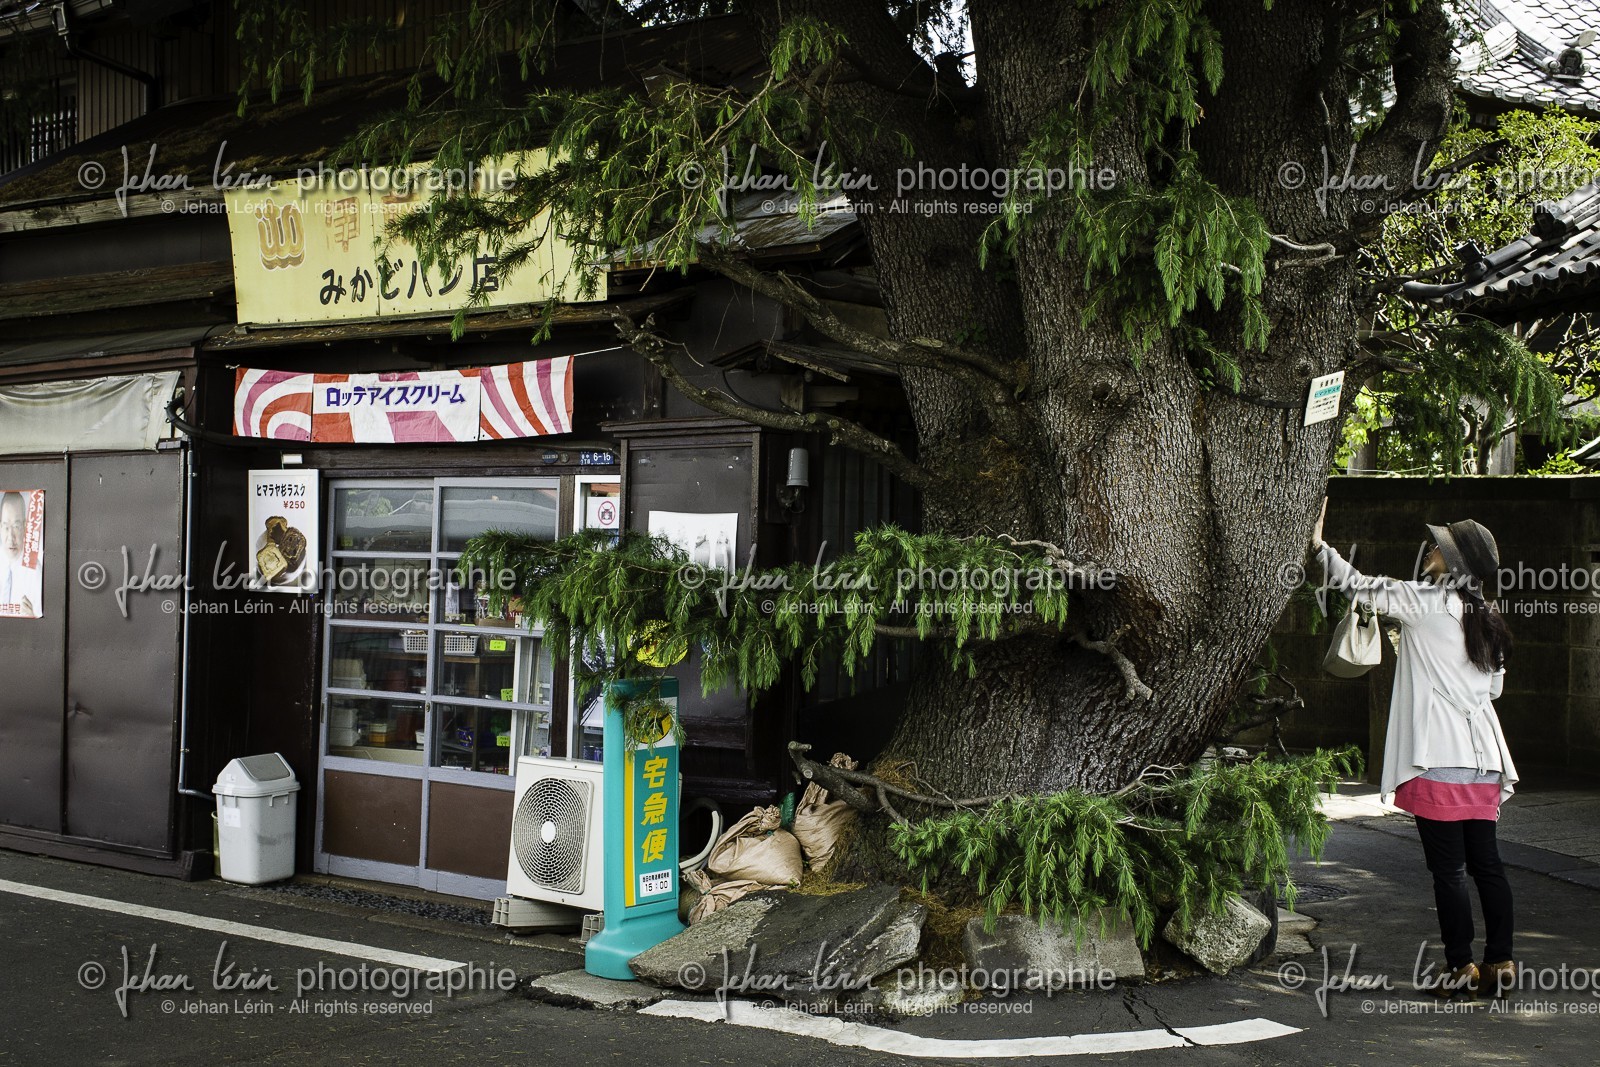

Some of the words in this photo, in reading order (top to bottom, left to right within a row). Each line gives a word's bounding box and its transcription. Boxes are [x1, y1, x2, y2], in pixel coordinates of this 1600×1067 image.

[326, 384, 466, 407] ロッテアイスクリーム
[256, 483, 306, 497] ヒマラヤ杉ラスク
[283, 500, 305, 509] ¥250
[641, 755, 668, 864] 宅急便
